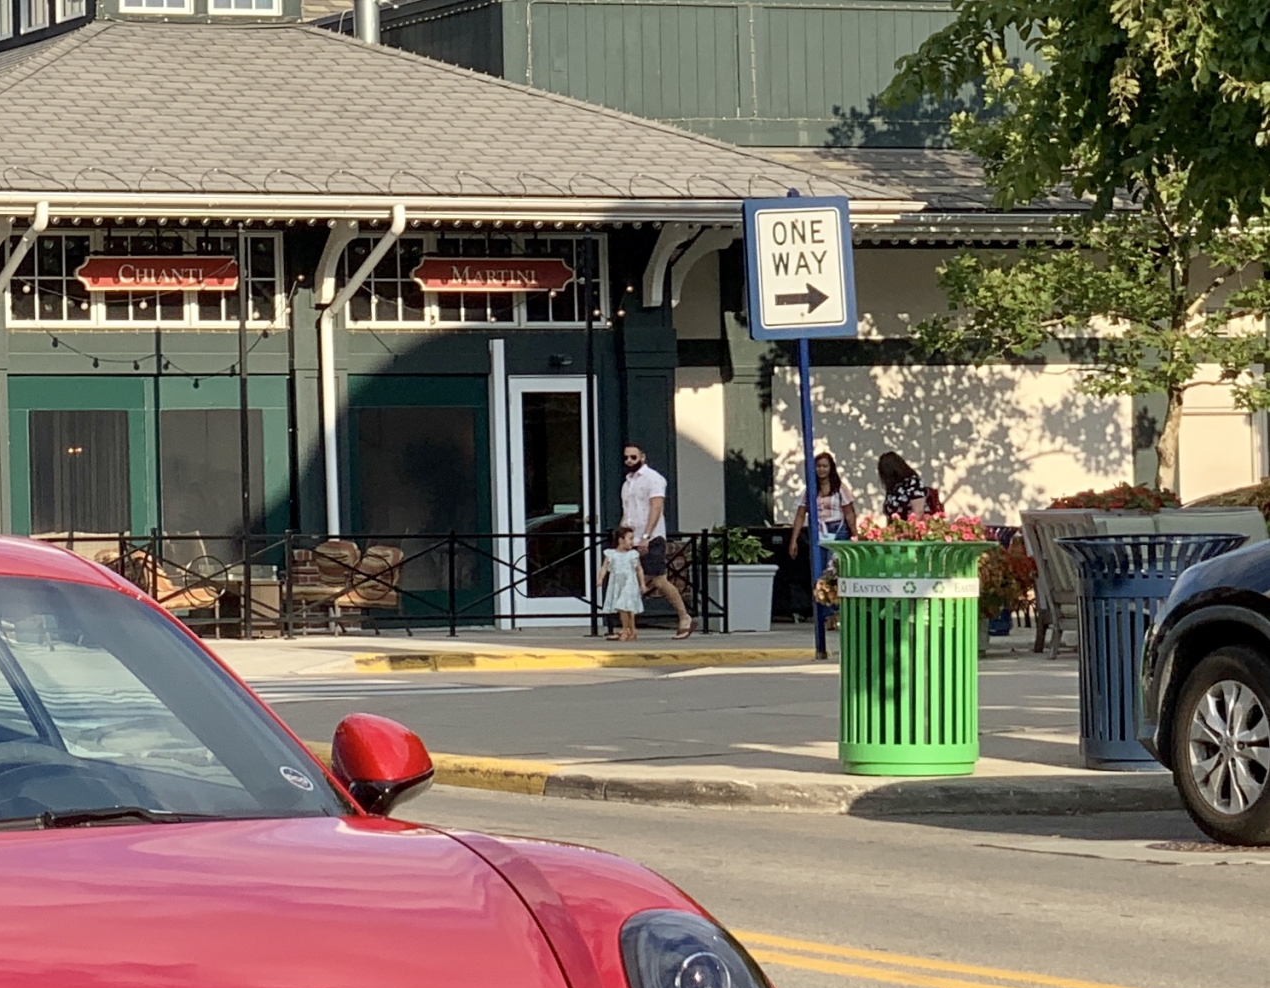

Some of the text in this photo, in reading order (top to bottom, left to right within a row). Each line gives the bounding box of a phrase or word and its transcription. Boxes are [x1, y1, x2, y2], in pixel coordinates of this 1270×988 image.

[772, 219, 825, 246] ONE
[118, 263, 204, 284] CHIANTI
[771, 249, 828, 276] WAY
[451, 265, 538, 285] MARTINI
